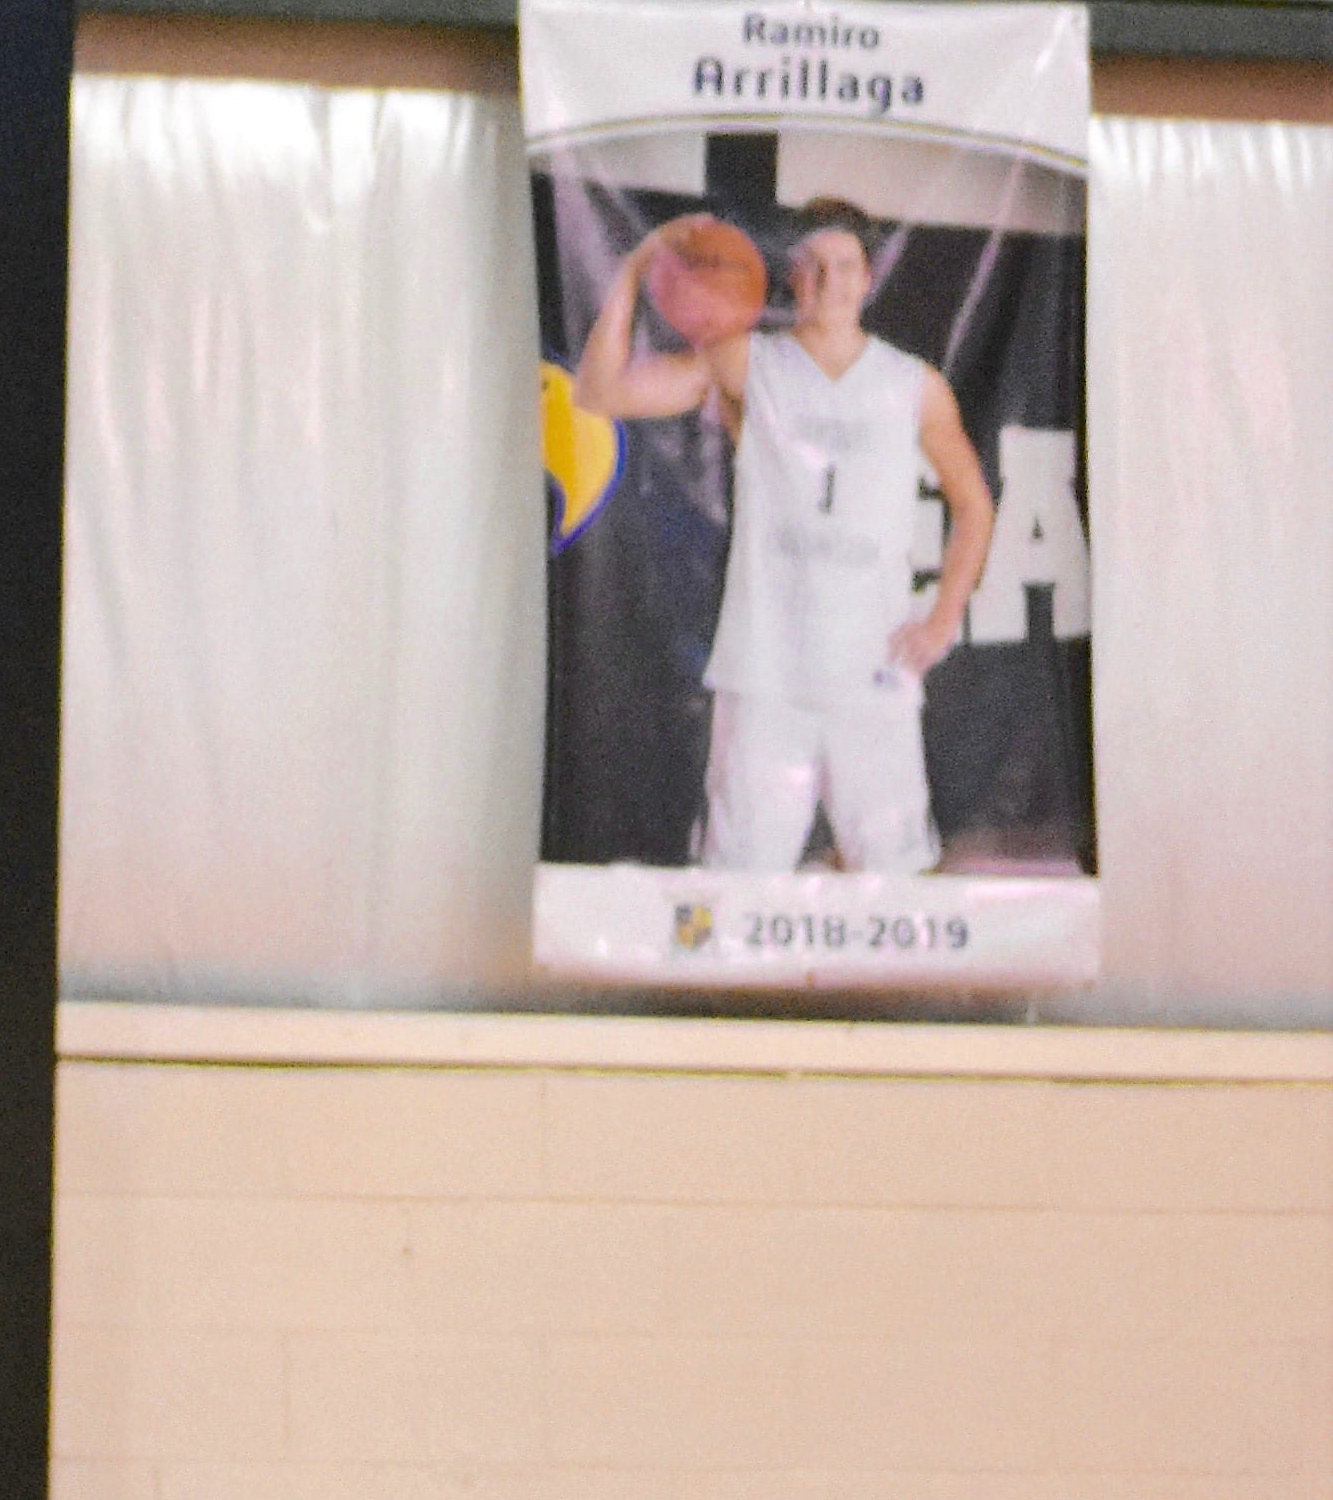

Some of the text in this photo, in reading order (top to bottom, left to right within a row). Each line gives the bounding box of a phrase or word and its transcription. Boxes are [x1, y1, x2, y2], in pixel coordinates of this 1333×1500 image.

[743, 11, 880, 50] Ramiro
[694, 55, 925, 117] Arrillaga
[742, 910, 970, 950] 2018-2019
